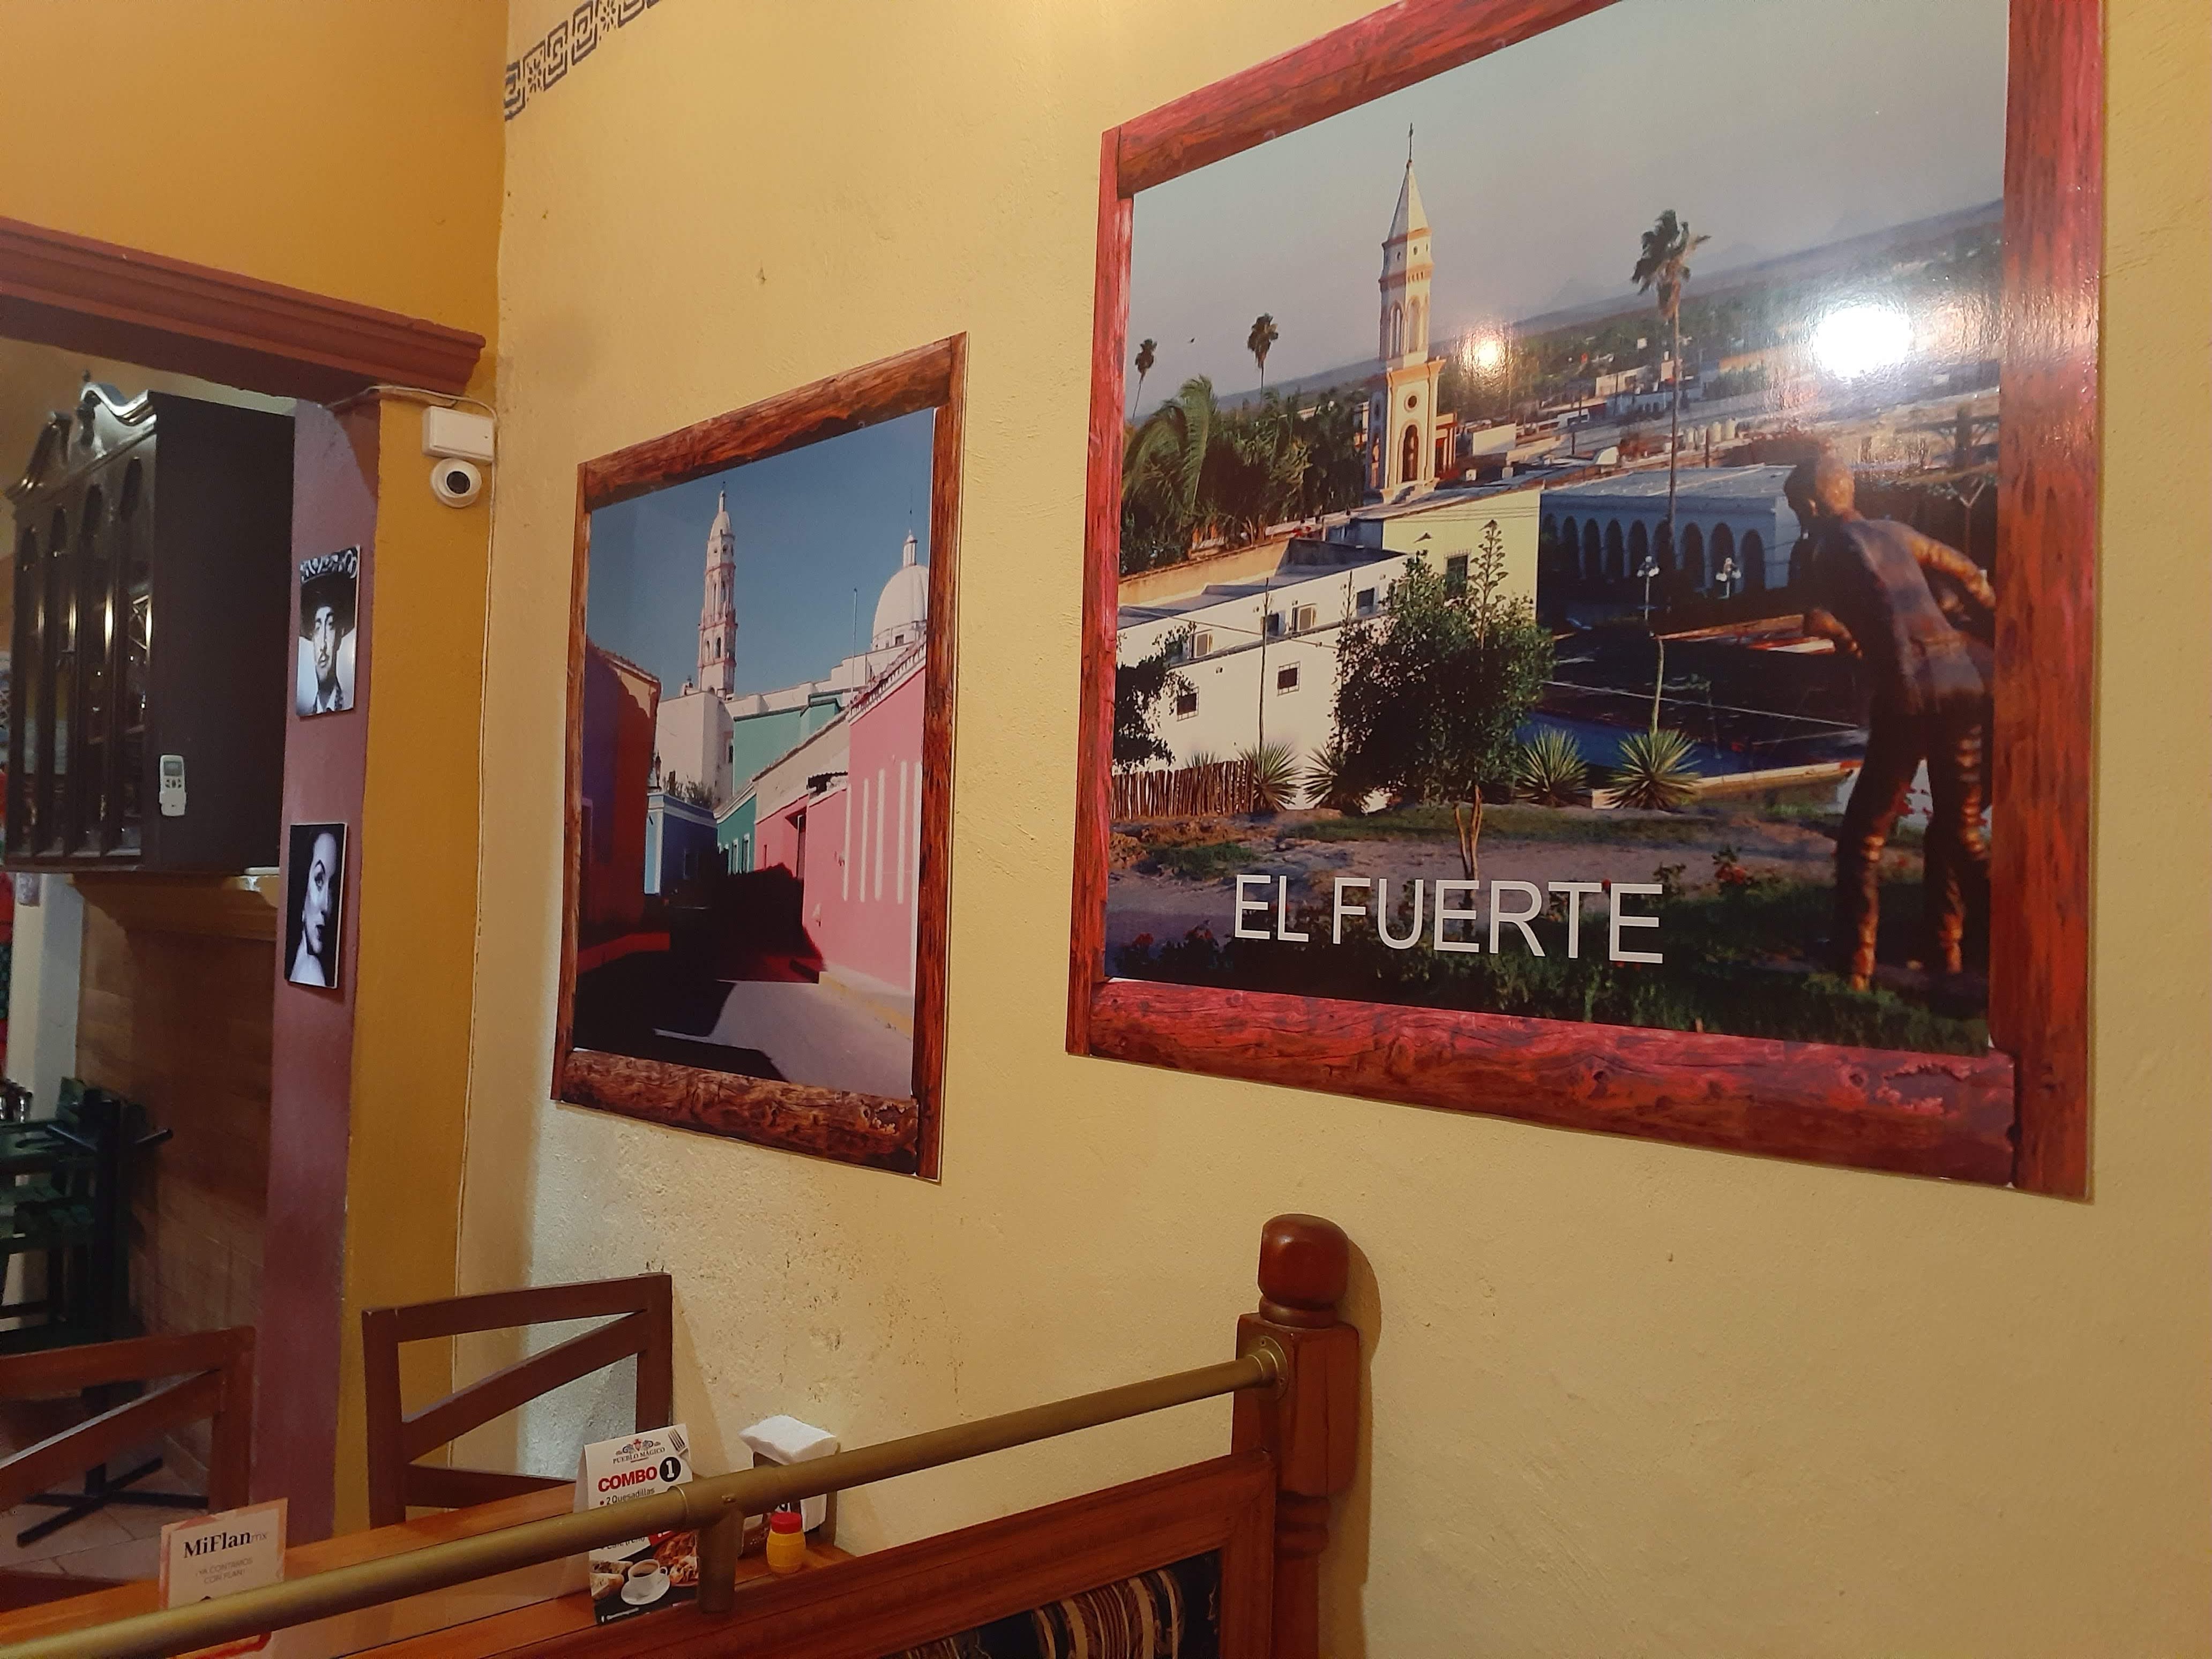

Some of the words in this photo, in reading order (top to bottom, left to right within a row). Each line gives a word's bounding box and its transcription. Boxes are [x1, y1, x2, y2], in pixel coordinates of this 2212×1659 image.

[1234, 874, 1309, 943] EL
[1332, 877, 1664, 964] FUERTE
[613, 1453, 639, 1464] PUEBLO
[597, 1466, 657, 1492] COMBO
[666, 1460, 675, 1478] 1
